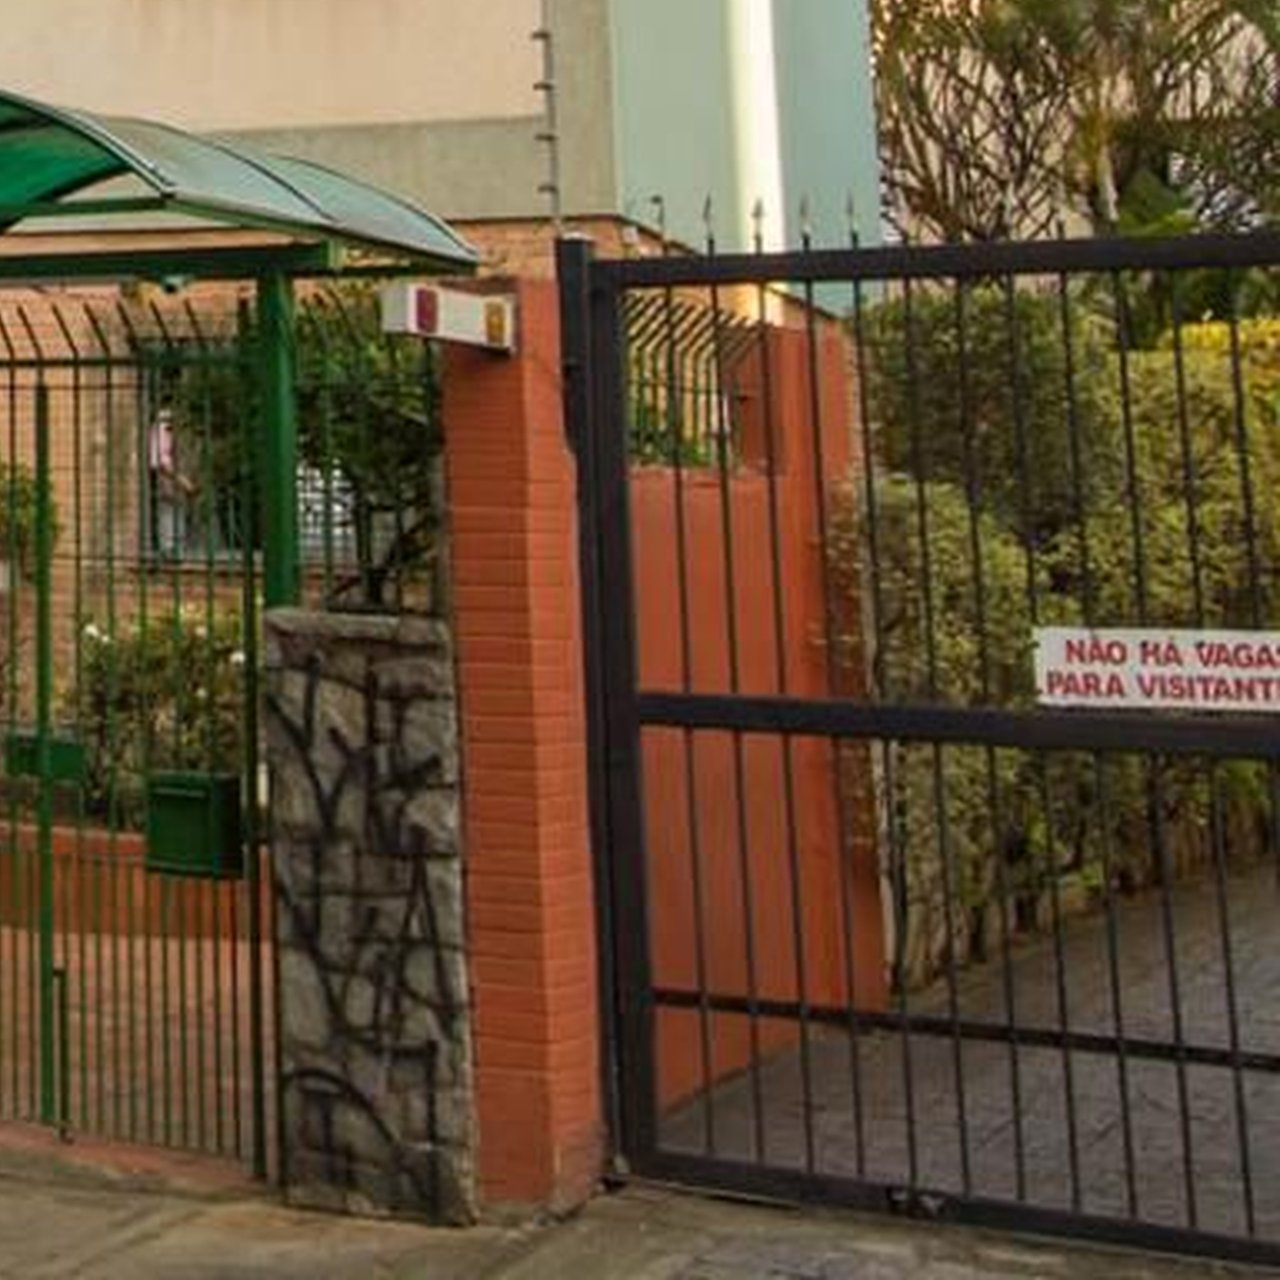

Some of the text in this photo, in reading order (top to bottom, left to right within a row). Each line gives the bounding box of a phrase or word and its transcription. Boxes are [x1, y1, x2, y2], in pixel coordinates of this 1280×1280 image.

[1064, 634, 1280, 669] NÃO HÁ VAGA
[1047, 672, 1280, 702] PARA VISITANT
